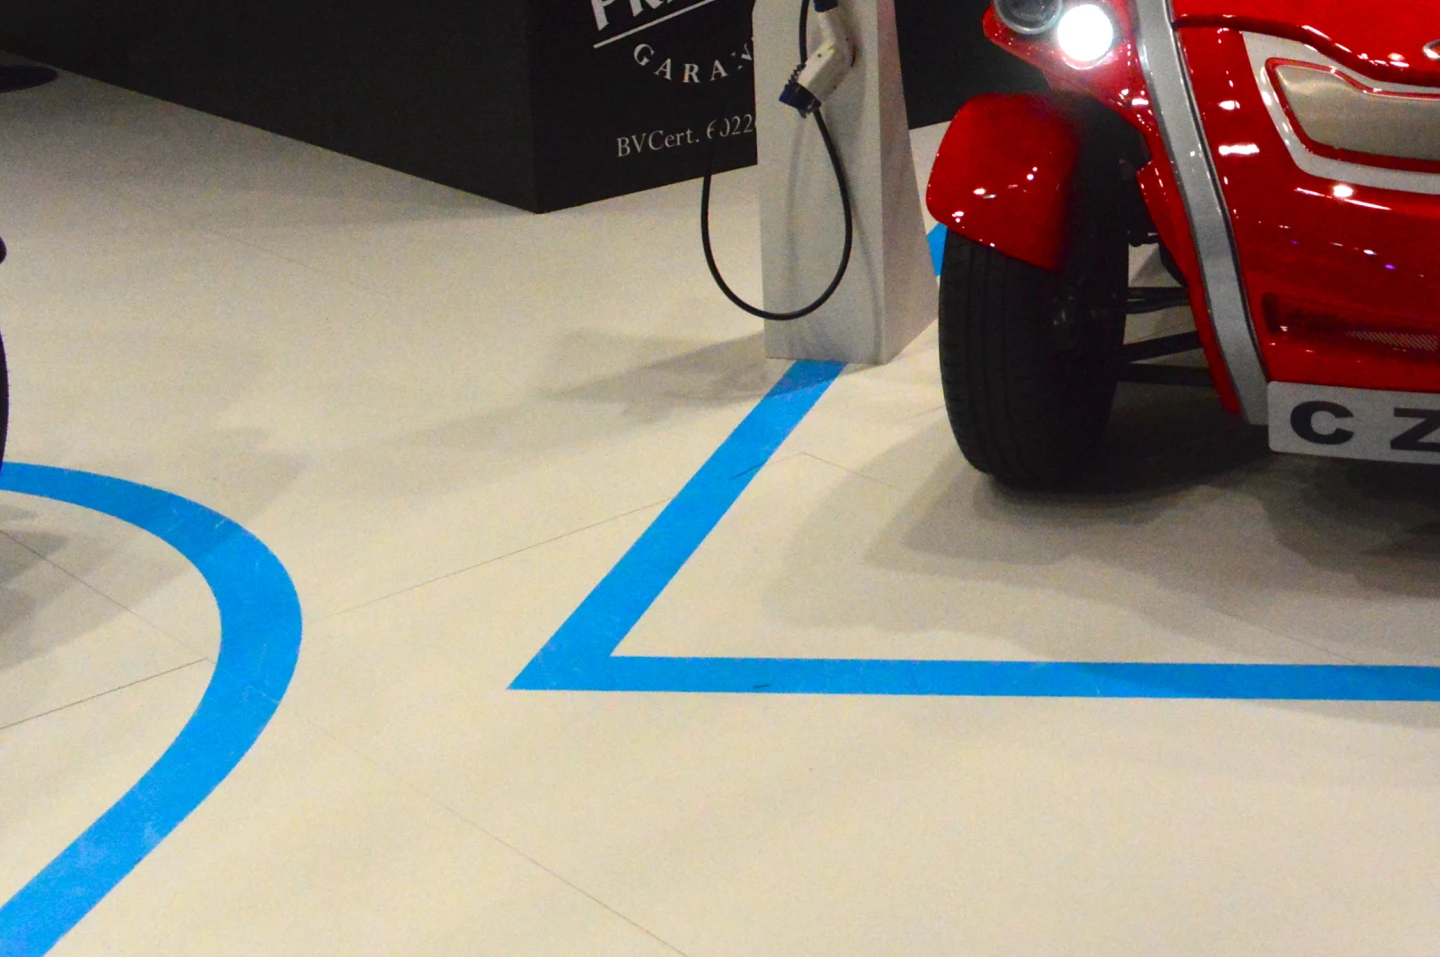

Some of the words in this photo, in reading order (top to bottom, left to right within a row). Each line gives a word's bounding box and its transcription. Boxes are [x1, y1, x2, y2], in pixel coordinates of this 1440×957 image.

[616, 128, 700, 158] BVCert.
[706, 113, 756, 140] 6022
[1289, 400, 1355, 446] C
